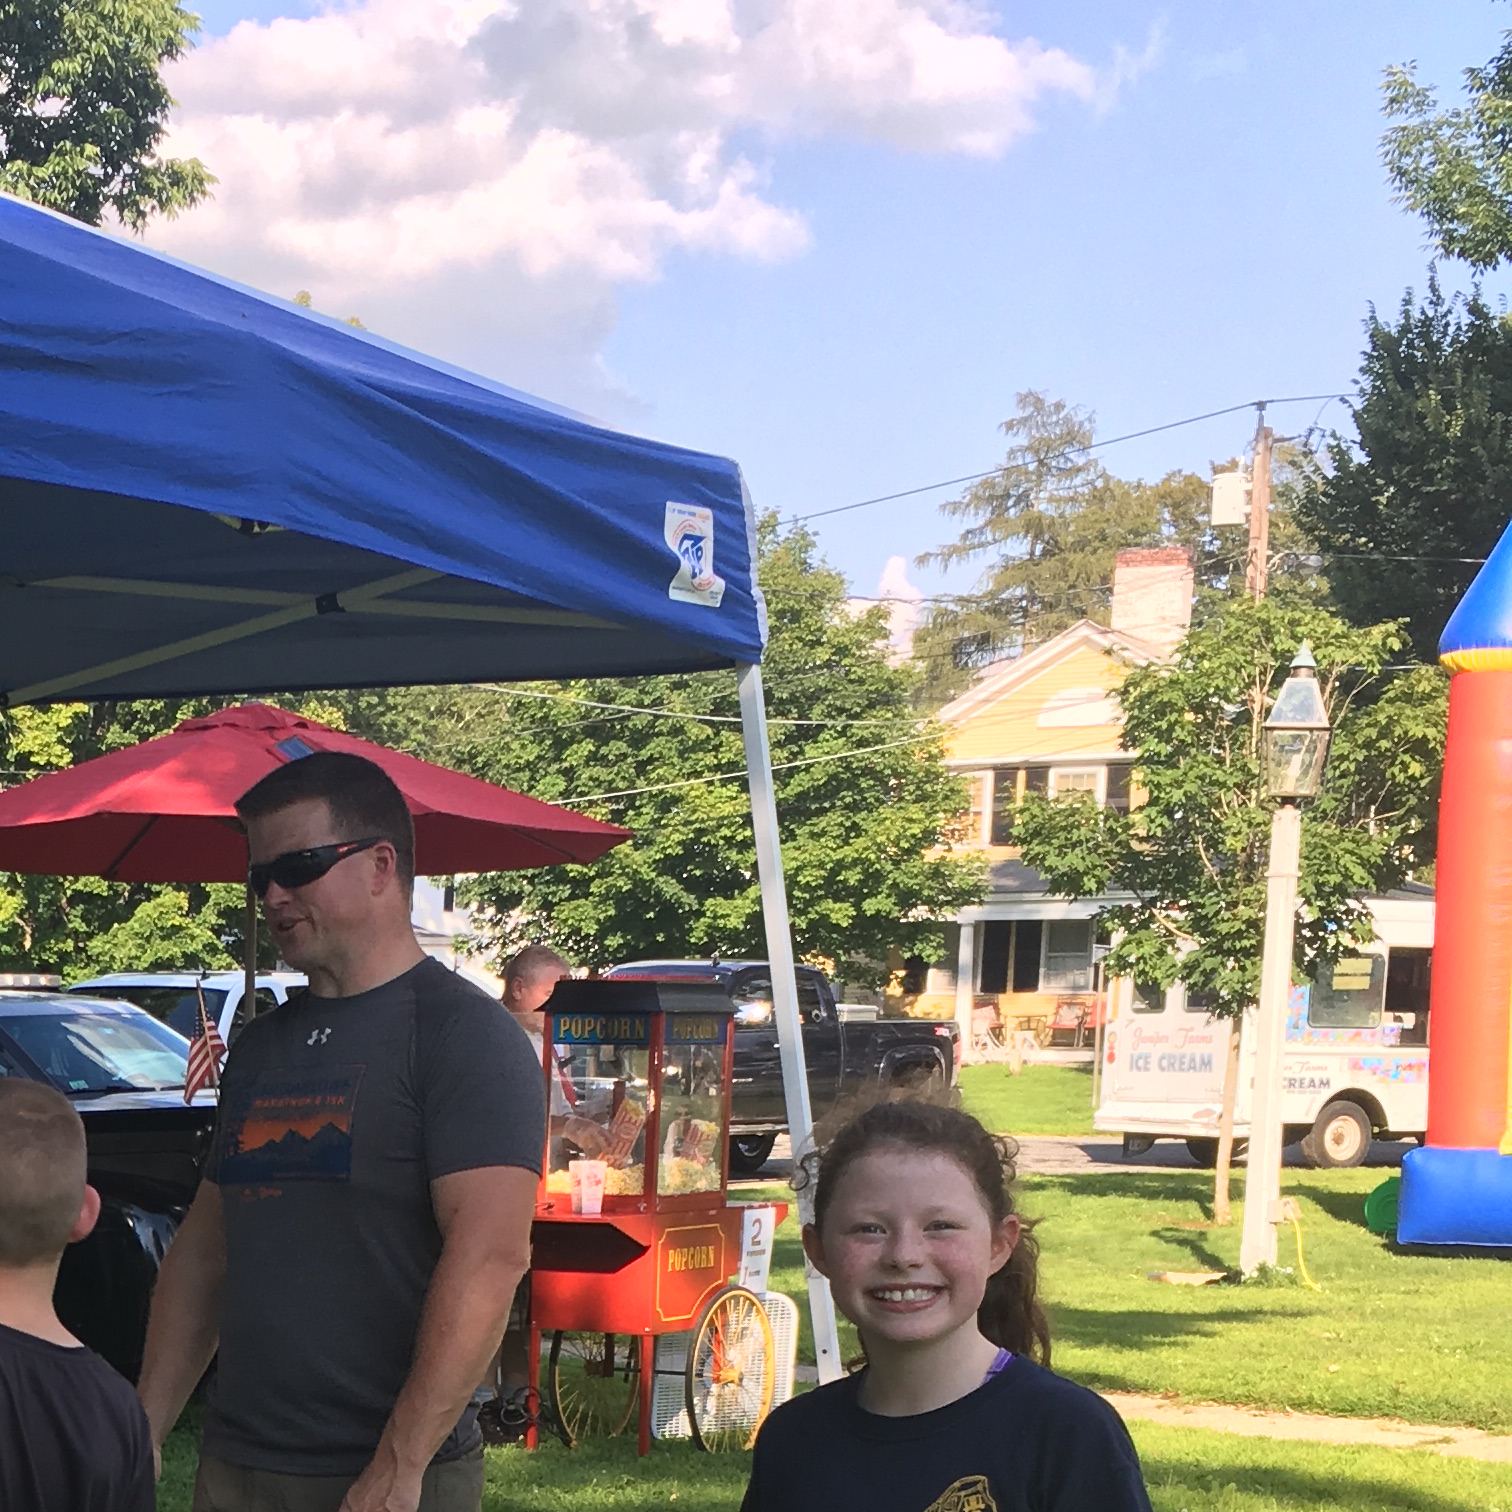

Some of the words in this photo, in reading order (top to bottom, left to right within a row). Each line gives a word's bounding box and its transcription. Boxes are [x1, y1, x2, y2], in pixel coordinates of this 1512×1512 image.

[559, 1017, 644, 1039] POPCORN
[1174, 1026, 1213, 1049] Farms
[1129, 1052, 1152, 1072] ICE
[1157, 1052, 1213, 1073] CREAM
[667, 1245, 715, 1272] POPCORN
